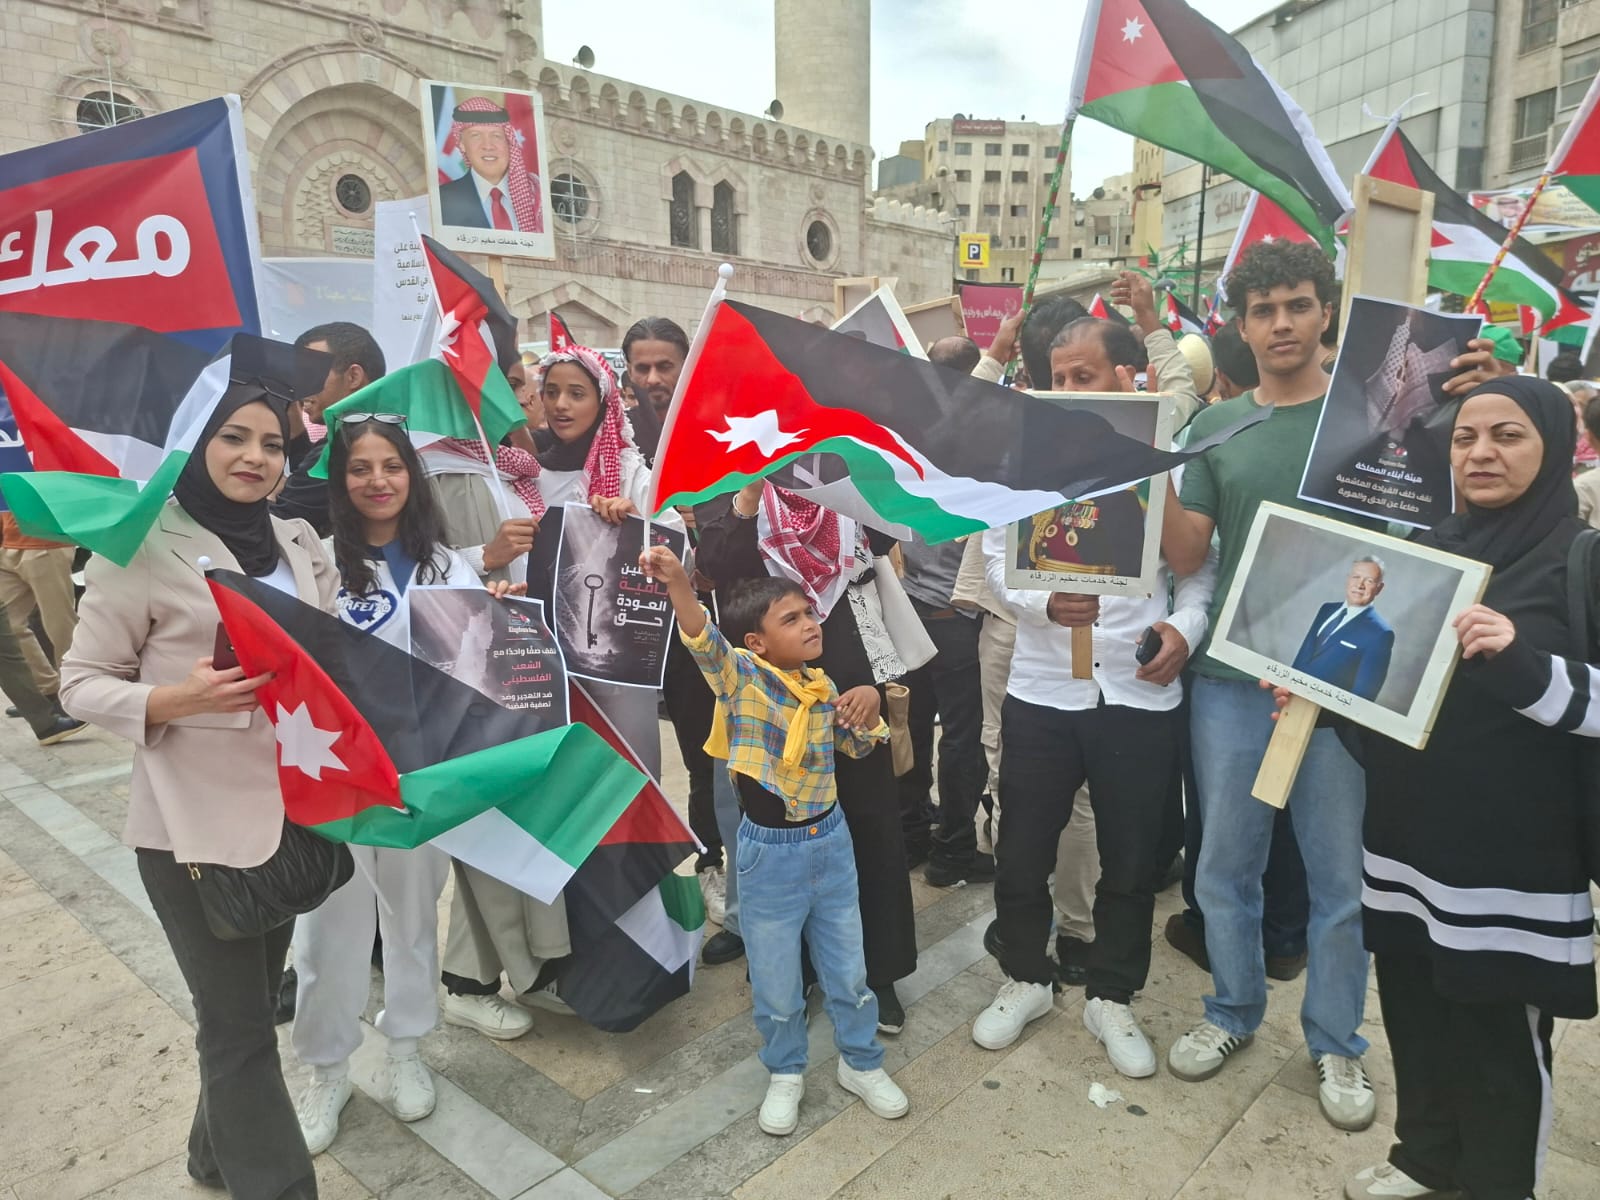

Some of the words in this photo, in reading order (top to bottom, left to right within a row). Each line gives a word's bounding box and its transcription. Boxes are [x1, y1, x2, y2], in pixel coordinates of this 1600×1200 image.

[969, 244, 980, 259] P
[395, 276, 419, 288] القدس
[1355, 462, 1387, 476] المملكة
[1030, 571, 1056, 582] الزرقاء
[1059, 575, 1078, 584] مخيم
[1081, 576, 1106, 584] خدمات
[1110, 577, 1128, 587] لجنة
[616, 593, 667, 612] العودة
[613, 608, 663, 627] حق
[511, 660, 541, 671] الشعب
[1266, 664, 1290, 678] الزرقاء
[502, 673, 552, 687] الفلسطيني
[1290, 676, 1308, 687] مخيم
[1309, 682, 1332, 698] خدمات
[1335, 690, 1352, 706] لجنة
